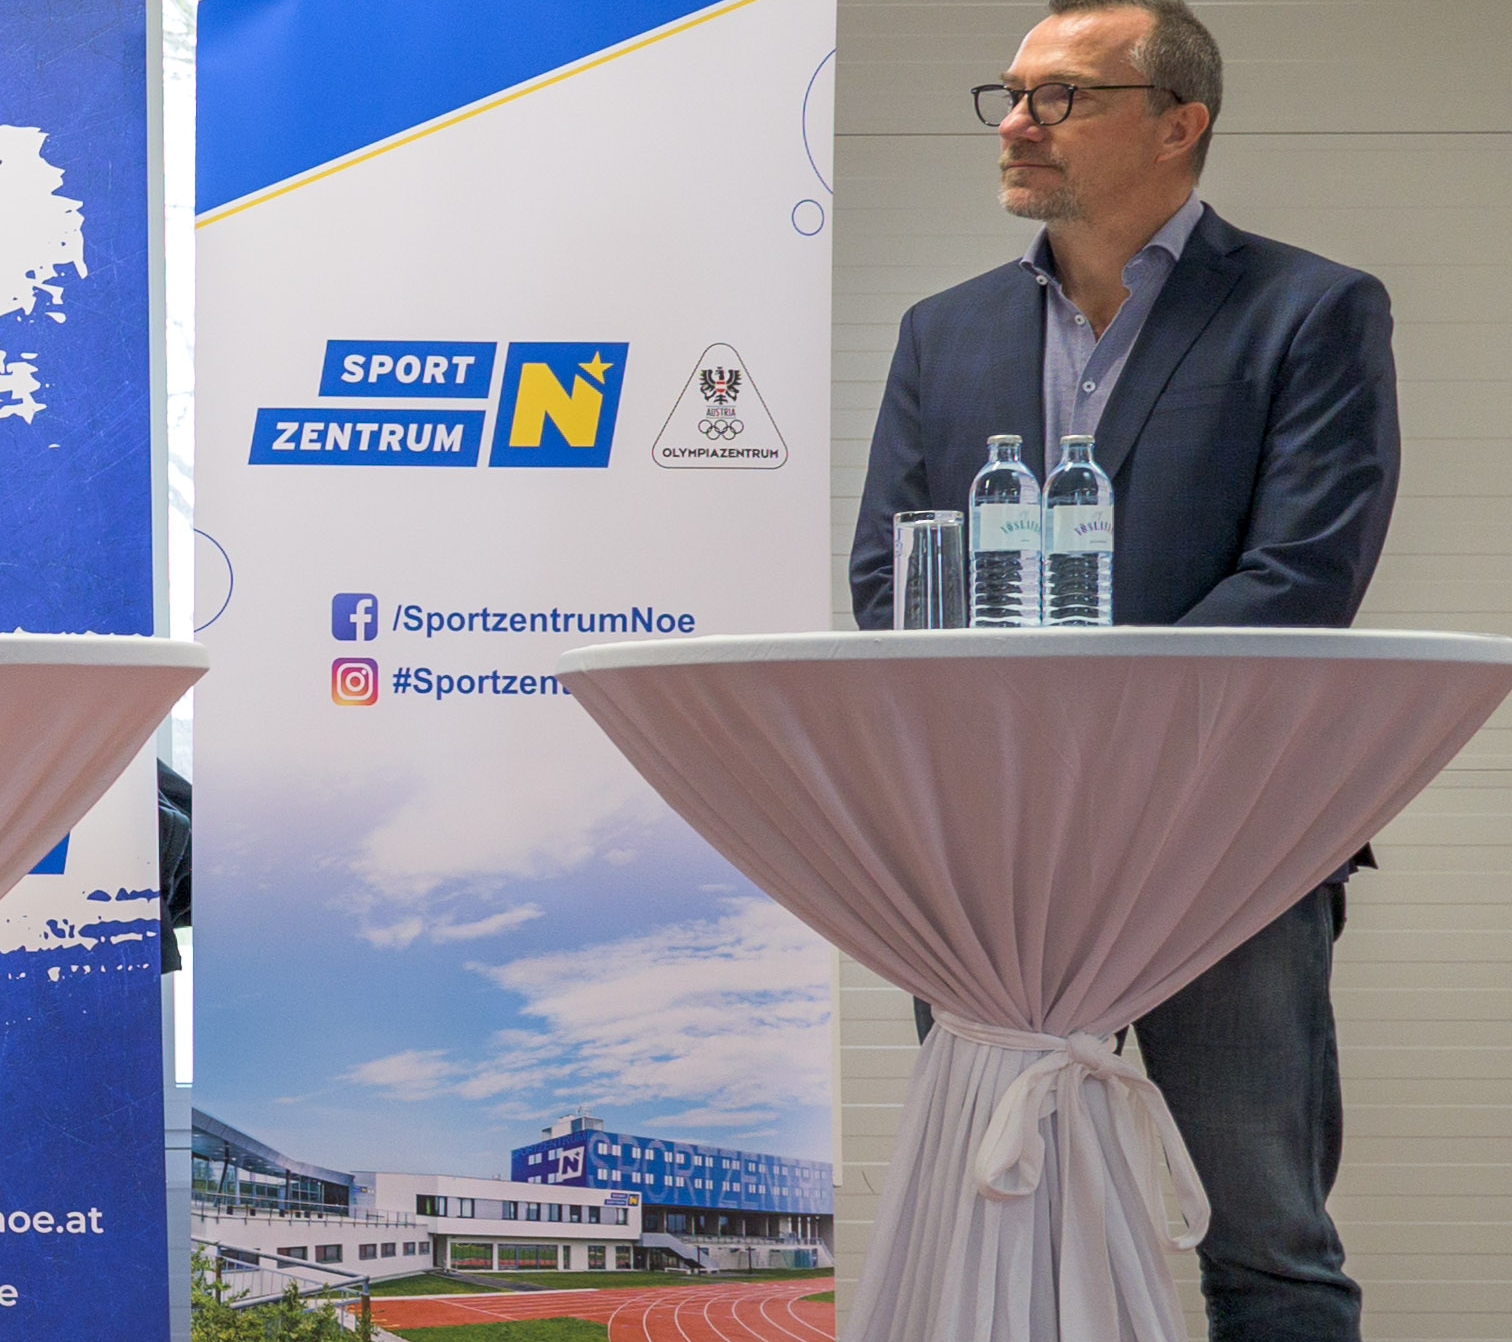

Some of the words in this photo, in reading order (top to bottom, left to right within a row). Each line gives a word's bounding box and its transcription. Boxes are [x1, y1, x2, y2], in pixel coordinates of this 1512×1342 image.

[341, 354, 476, 384] SPORT
[271, 421, 464, 452] ZENTRUM
[662, 447, 779, 459] OLYMPIAZENTRUM
[392, 605, 695, 638] /SportzentrumNoe
[393, 667, 571, 701] #Sportzen
